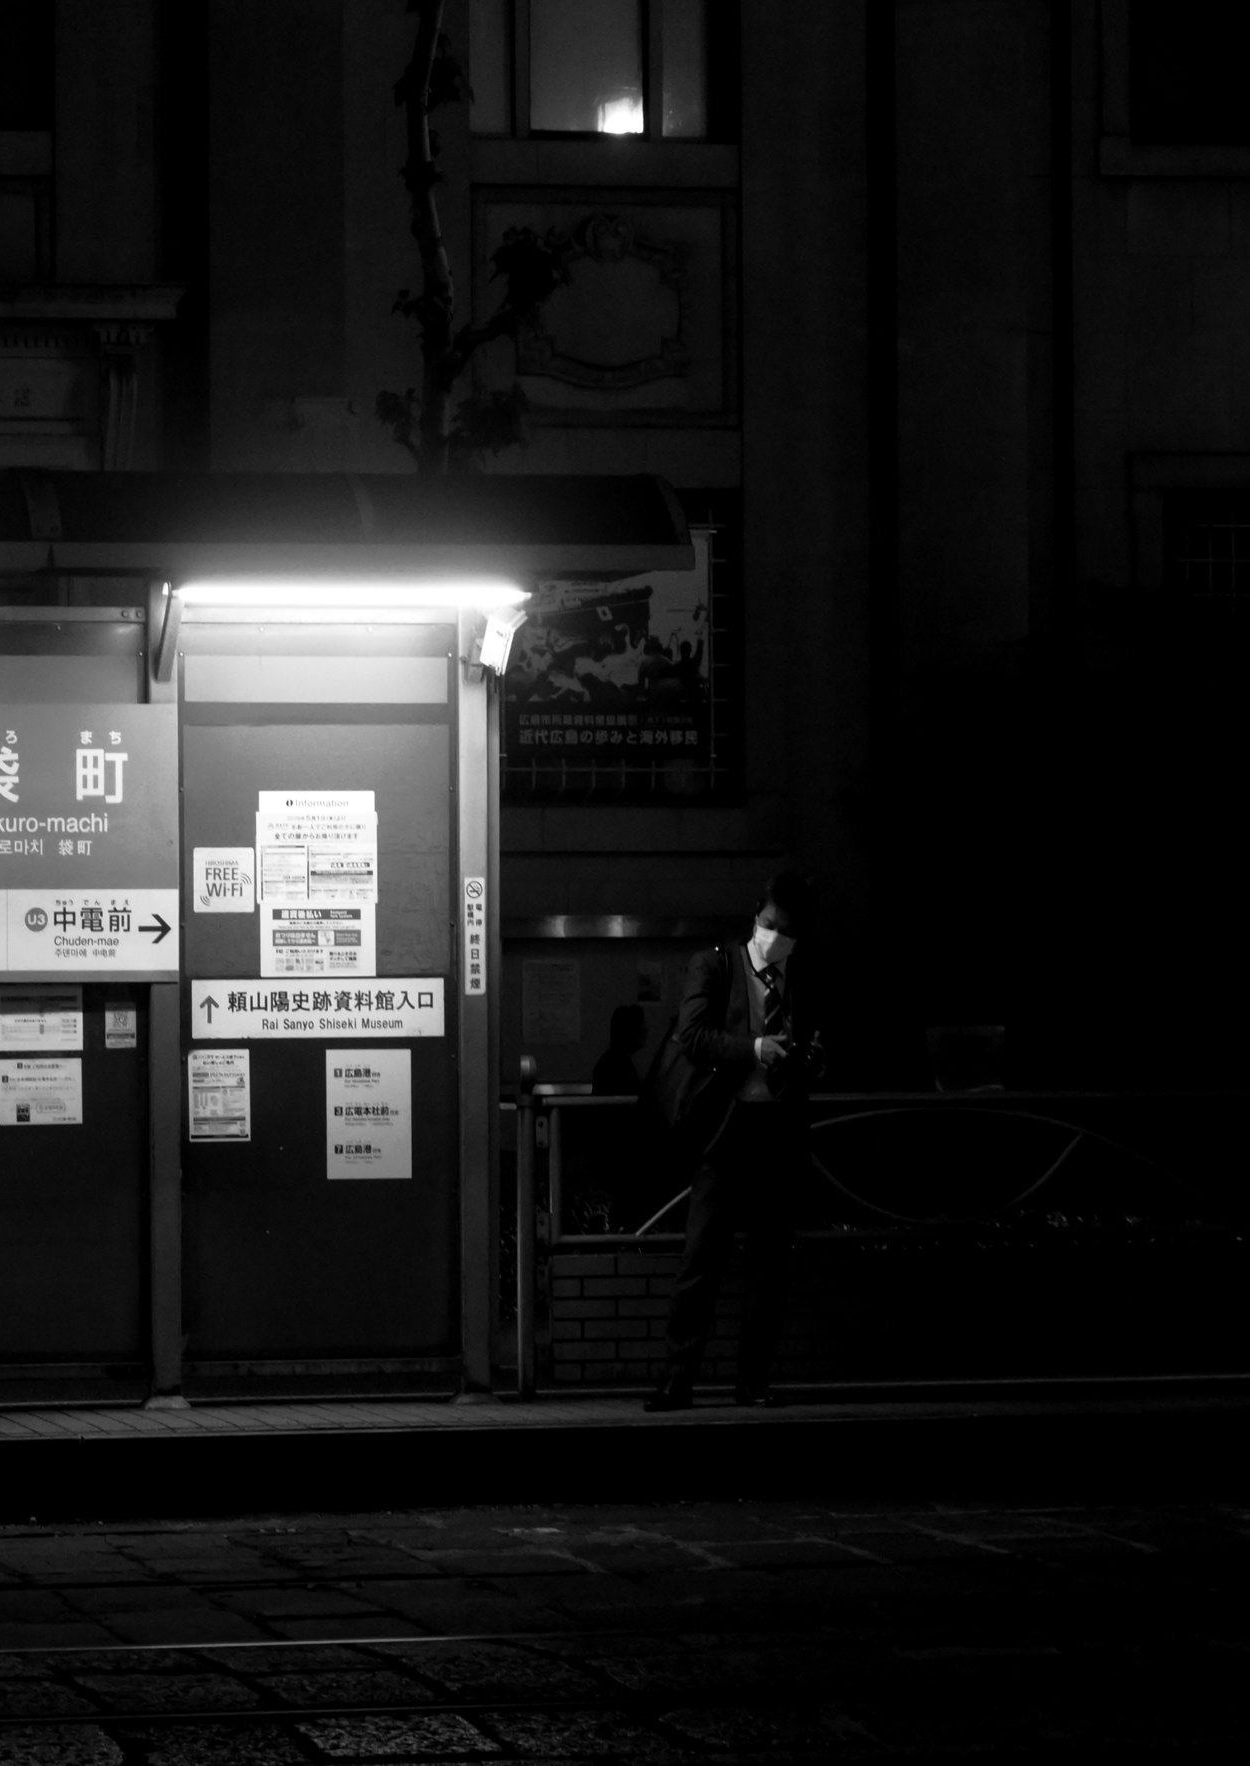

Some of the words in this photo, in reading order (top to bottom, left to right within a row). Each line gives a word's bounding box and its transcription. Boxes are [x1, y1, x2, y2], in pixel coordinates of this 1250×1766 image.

[79, 729, 122, 744] まち
[518, 728, 699, 745] 近代広島の歩みと海外移民
[295, 798, 349, 808] Information
[205, 867, 239, 881] FREE
[206, 882, 243, 897] Wi-Fi
[27, 914, 46, 926] U3
[53, 906, 132, 934] 中電前
[54, 935, 120, 947] Chuden-mae
[470, 933, 481, 989] 終日禁煙
[227, 990, 435, 1013] 頼山陽史跡資料館入口
[262, 1018, 279, 1030] Rai
[283, 1018, 315, 1031] Sanyo
[319, 1017, 357, 1030] Shiseki
[361, 1017, 404, 1030] Museum
